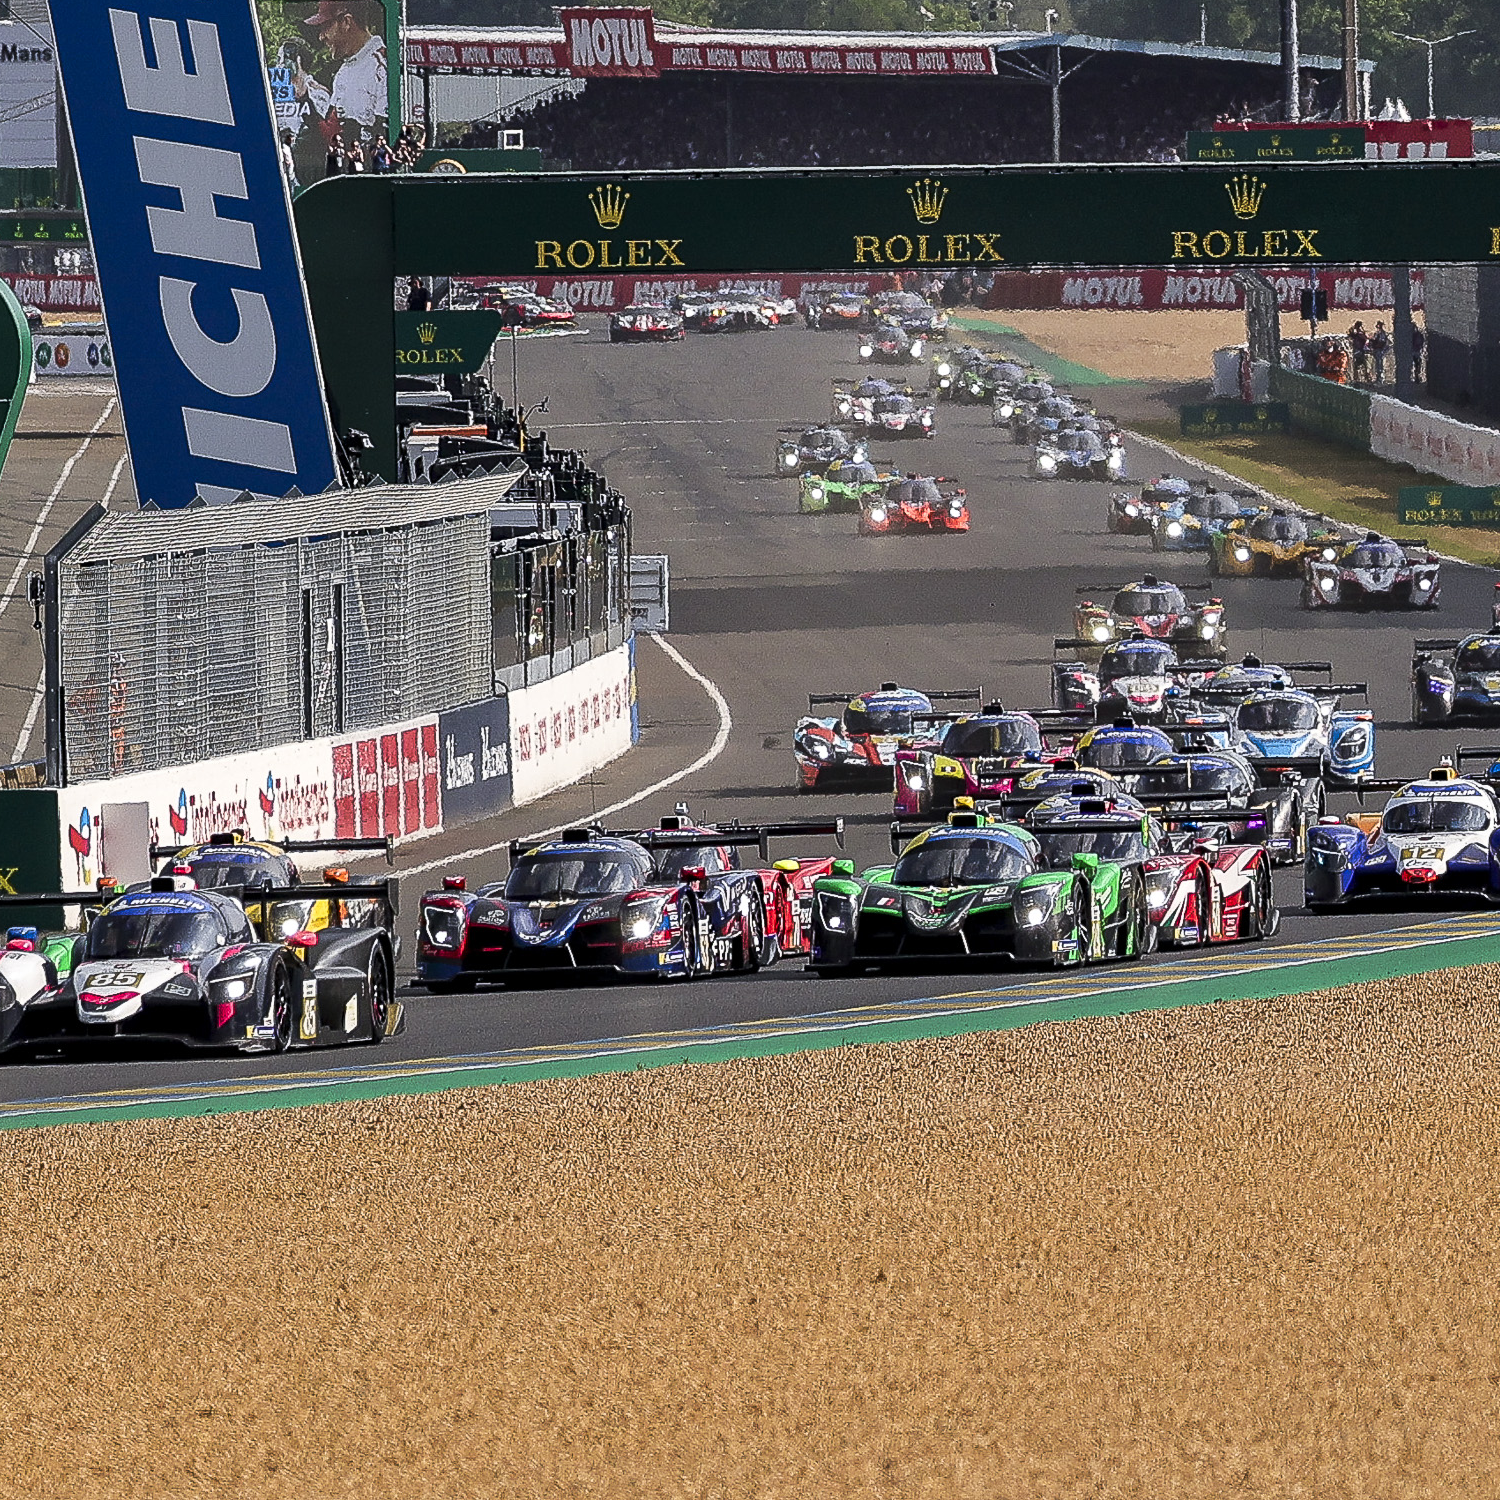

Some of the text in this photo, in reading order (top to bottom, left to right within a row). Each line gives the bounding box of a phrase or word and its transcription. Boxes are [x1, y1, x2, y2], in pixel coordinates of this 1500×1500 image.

[0, 43, 53, 64] Mans
[571, 17, 654, 68] MOTUL
[537, 240, 683, 268] ROLEX
[856, 235, 1001, 262] ROLEX
[1174, 230, 1320, 257] ROLEX
[552, 279, 616, 307] MOTUL
[1062, 276, 1144, 306] MOTUL
[1161, 275, 1237, 305] MOTU
[1409, 847, 1438, 860] 12
[130, 897, 206, 910] MICHELIN
[89, 972, 139, 987] 85
